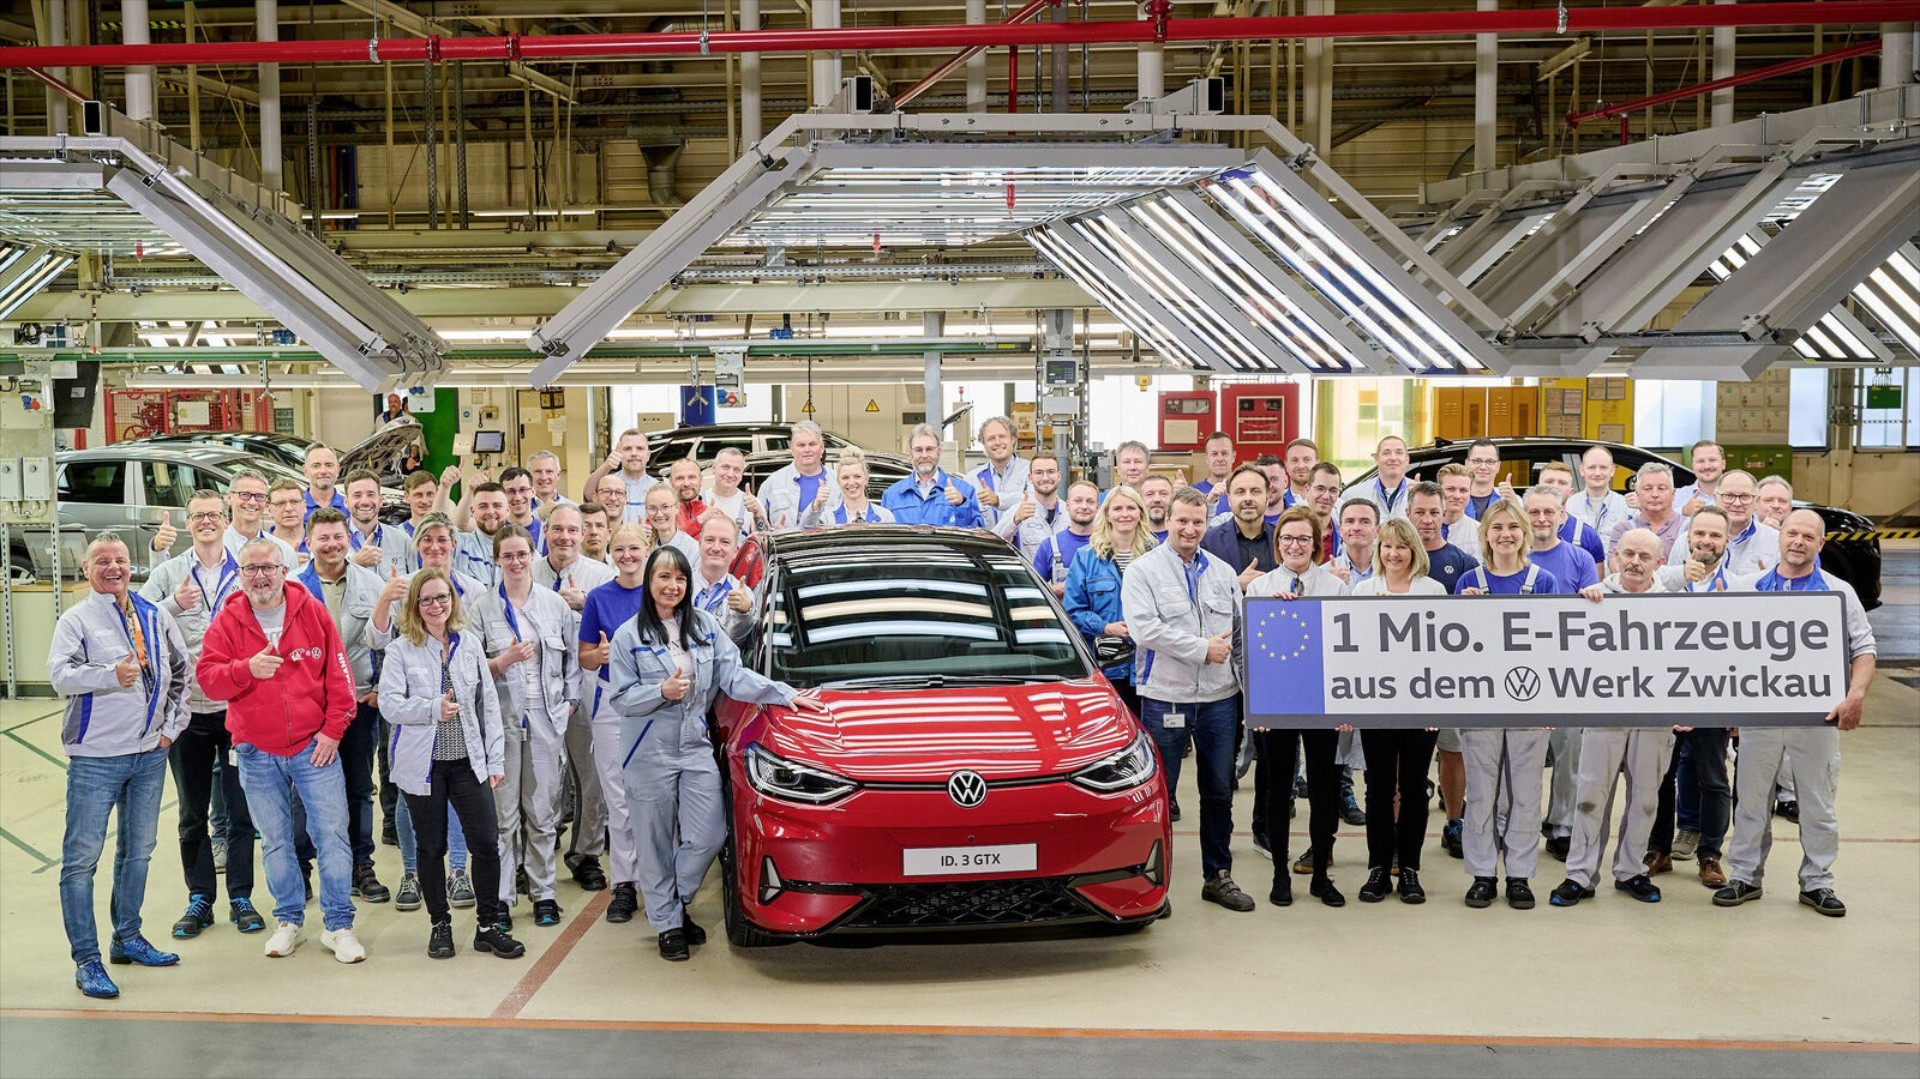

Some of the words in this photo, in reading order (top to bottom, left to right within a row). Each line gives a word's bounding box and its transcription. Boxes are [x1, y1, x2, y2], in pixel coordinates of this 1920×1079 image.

[1333, 613, 1359, 652] 1
[1379, 610, 1484, 653] Mio.
[1503, 609, 1829, 661] E-Fahrzeuge
[1331, 675, 1397, 699] aus
[1409, 667, 1495, 699] dem
[1548, 666, 1655, 698] Werk
[1667, 665, 1831, 698] Zwickau
[941, 855, 958, 867] ID.
[962, 855, 970, 866] 3
[973, 853, 1001, 866] GTX
